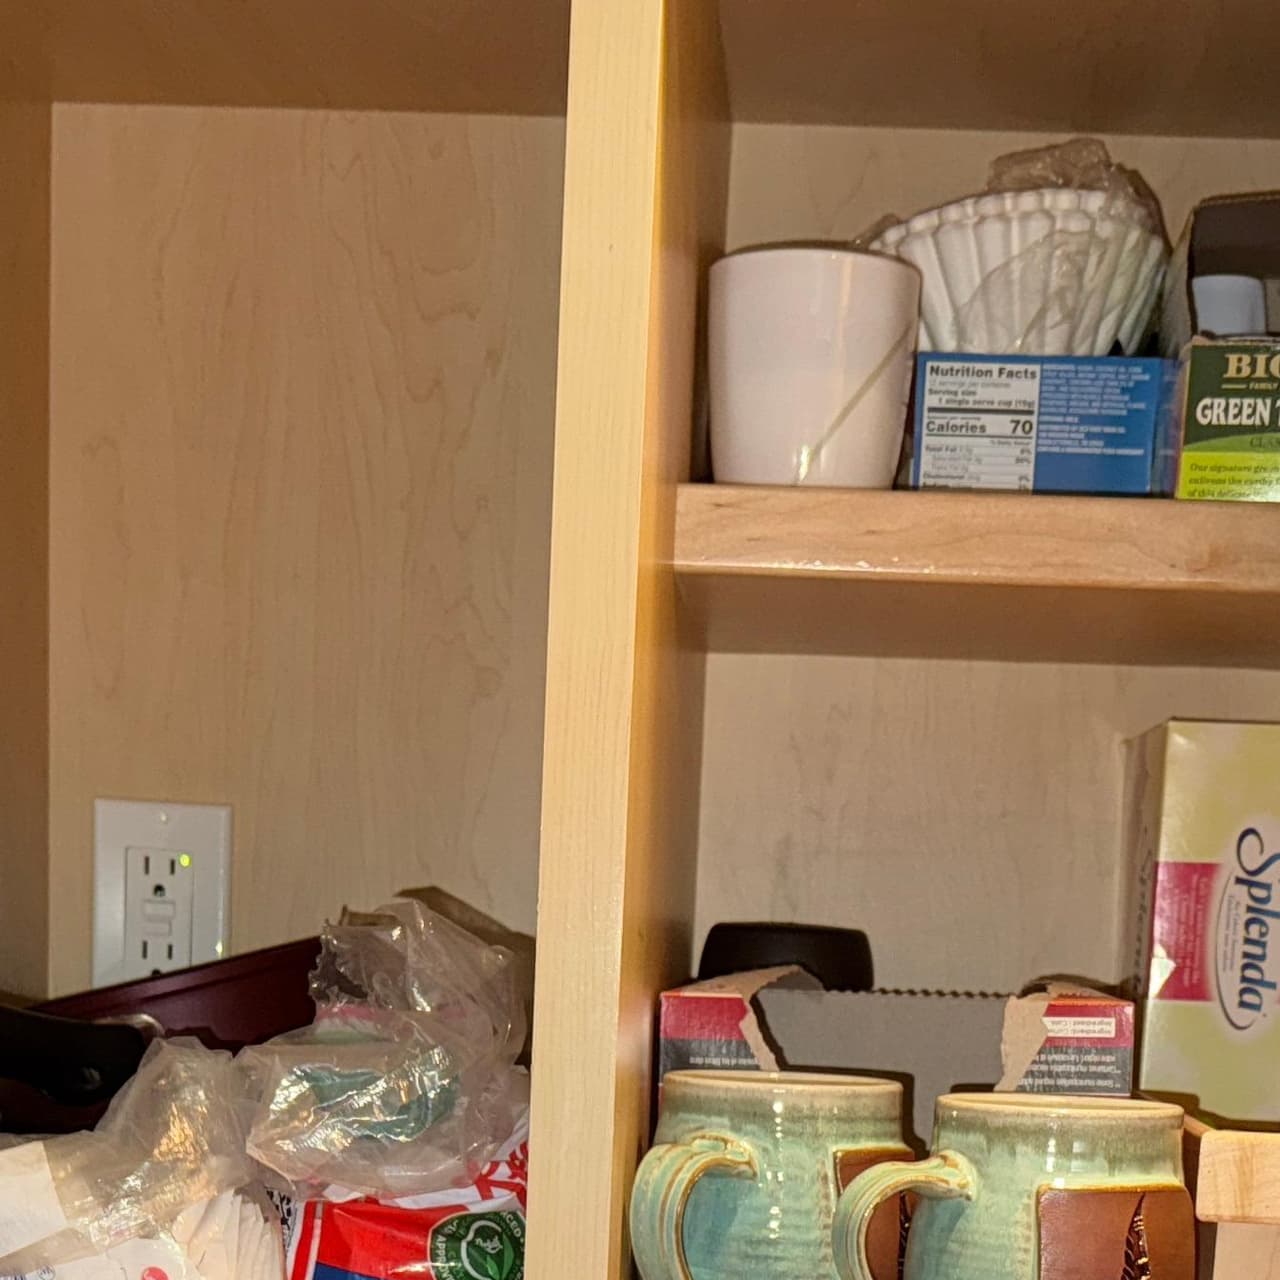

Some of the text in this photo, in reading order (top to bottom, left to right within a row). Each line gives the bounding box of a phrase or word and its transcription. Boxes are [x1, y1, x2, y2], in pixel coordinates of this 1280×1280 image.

[929, 365, 1038, 380] Nutrition Facts
[928, 388, 959, 397] Serving
[1196, 397, 1271, 427] GREEN
[926, 421, 987, 434] Calories
[1009, 420, 1033, 435] 70
